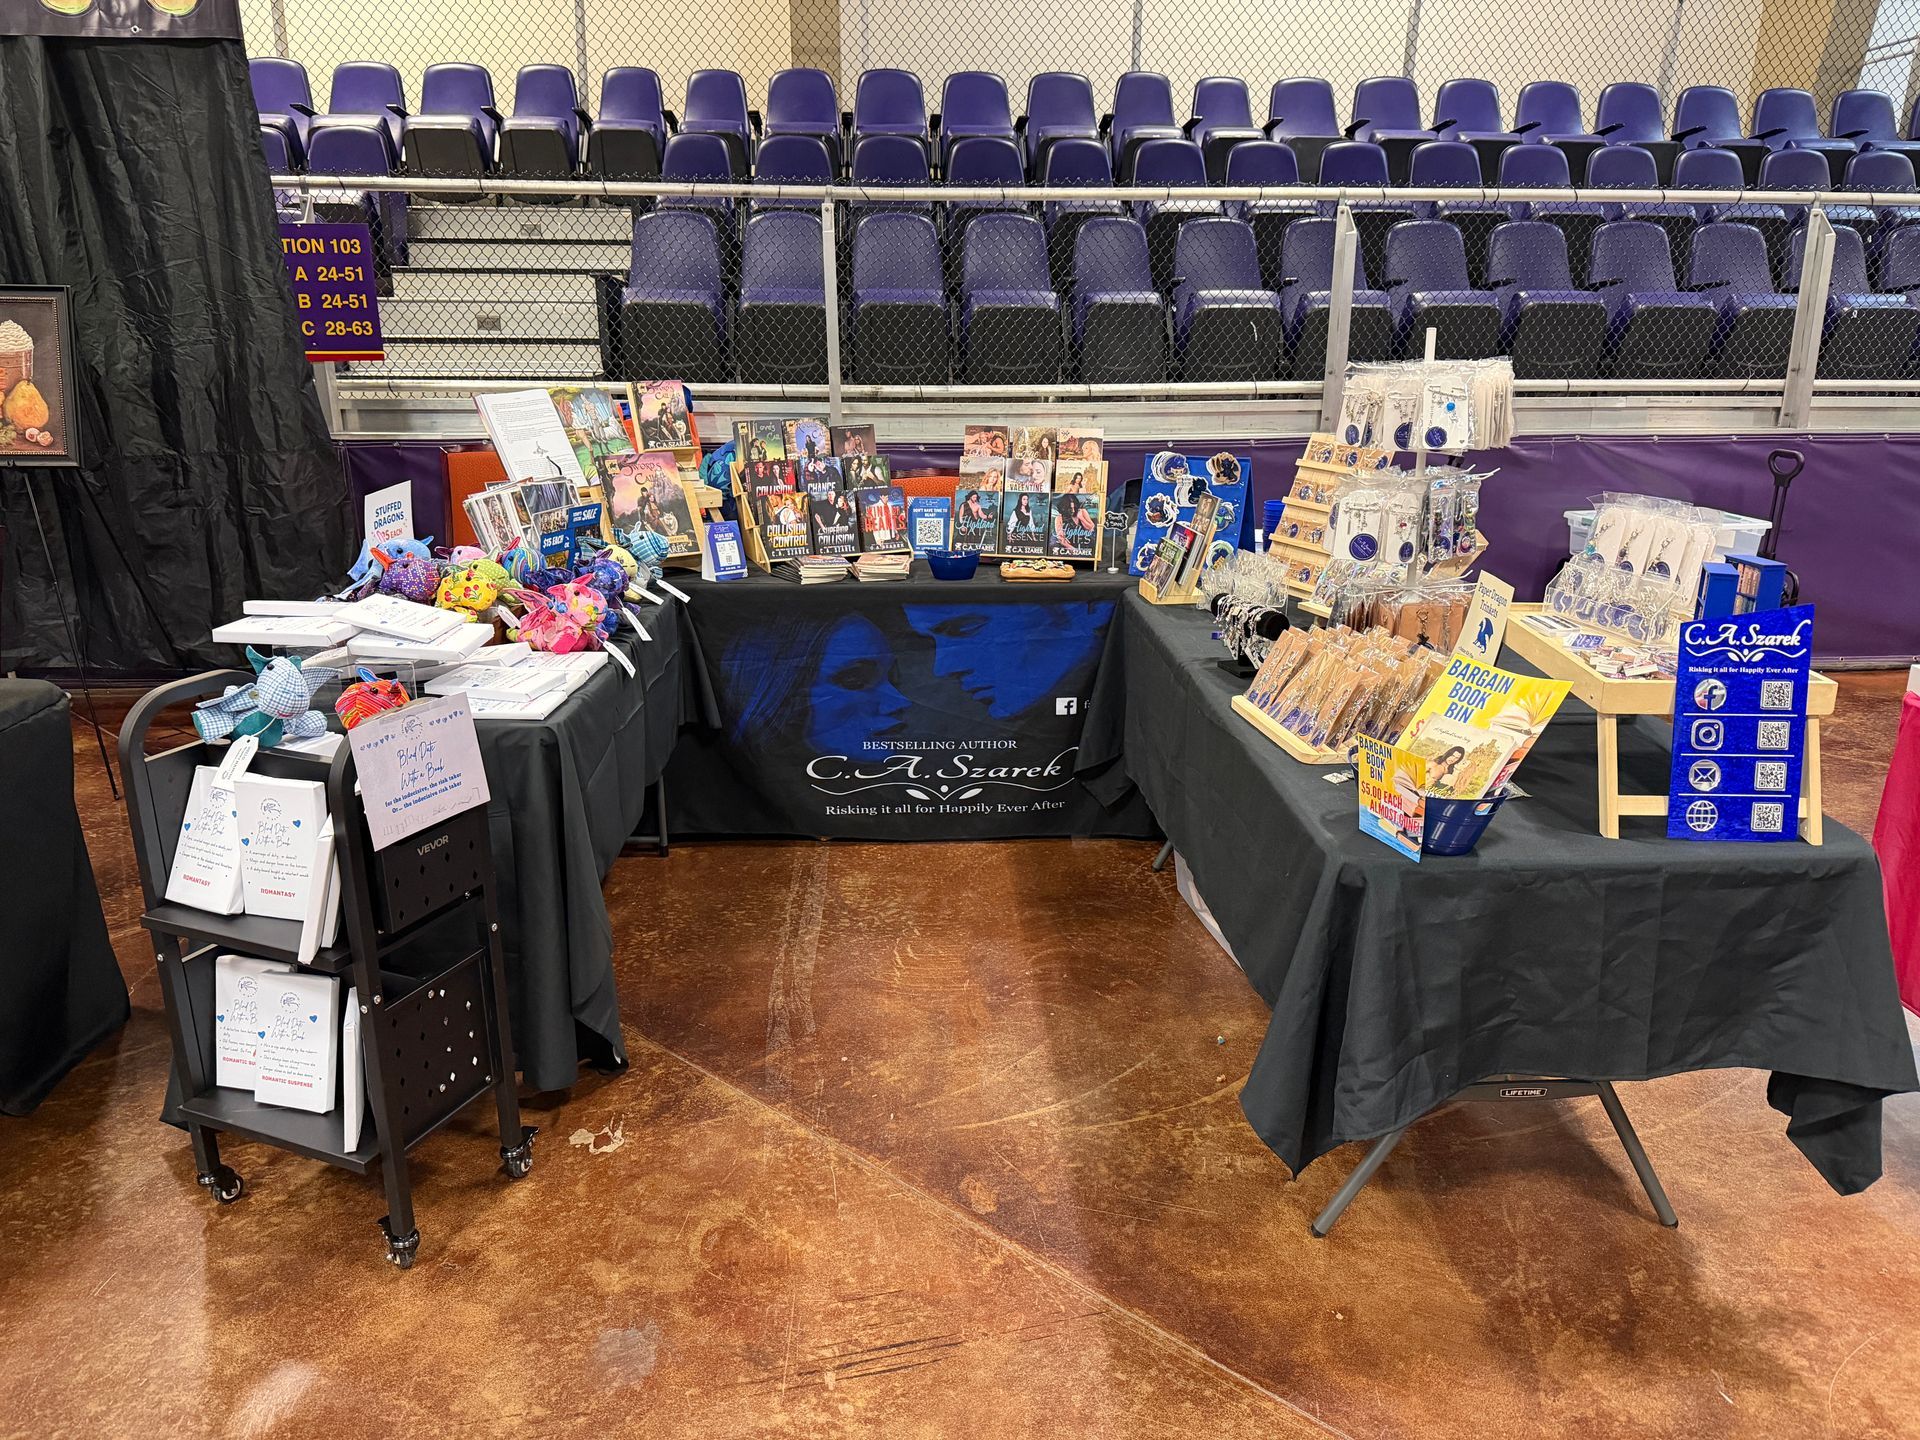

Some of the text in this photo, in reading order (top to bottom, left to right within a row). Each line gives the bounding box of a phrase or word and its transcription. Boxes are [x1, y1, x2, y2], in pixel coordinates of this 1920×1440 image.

[281, 238, 361, 254] TION 103
[295, 266, 364, 281] A 24-51
[298, 294, 367, 309] B 24-51
[302, 321, 373, 336] C 28-63
[756, 484, 795, 497] COLLISION
[1009, 482, 1044, 492] VALENTINE
[375, 501, 402, 517] STUFFED
[582, 508, 599, 521] SALE
[373, 511, 405, 530] DRAGONS
[390, 528, 403, 539] EACH
[767, 523, 807, 537] COLLISION
[552, 535, 564, 546] EACH
[773, 535, 809, 548] CONTROL
[818, 533, 854, 545] COLLISION
[1007, 533, 1044, 543] ESSENCE
[668, 543, 687, 553] AREK
[1025, 546, 1043, 554] SZAREK
[1479, 582, 1508, 607] Paper Dragon
[1480, 600, 1498, 618] Trinkets
[1447, 659, 1515, 694] BARGAIN
[1688, 666, 1712, 674] Risking
[1740, 667, 1764, 675] Happily
[1448, 681, 1492, 710] BOOK
[1444, 701, 1475, 724] BIN
[862, 739, 1018, 751] BESTSELLING AUTHOR
[1359, 736, 1392, 760] BARGAIN
[1366, 752, 1386, 771] BOOK
[1370, 767, 1383, 782] BIN
[385, 799, 393, 808] for
[393, 797, 402, 805] the
[429, 781, 438, 789] the
[438, 776, 448, 785] risk
[449, 772, 462, 781] taker
[413, 791, 438, 805] indecisive
[438, 786, 449, 794] risk
[449, 781, 462, 790] taker
[1361, 781, 1382, 799] $5.00
[1383, 789, 1403, 810] EACH
[825, 800, 1067, 818] Risking it all for Happily Ever After
[1370, 800, 1421, 835] ALMOST GONE!
[417, 835, 449, 856] VEVOR
[183, 873, 211, 887] ROMANTASY
[260, 888, 296, 898] ROMANTASY
[261, 1075, 313, 1088] ROMANTIC SUSPENSE
